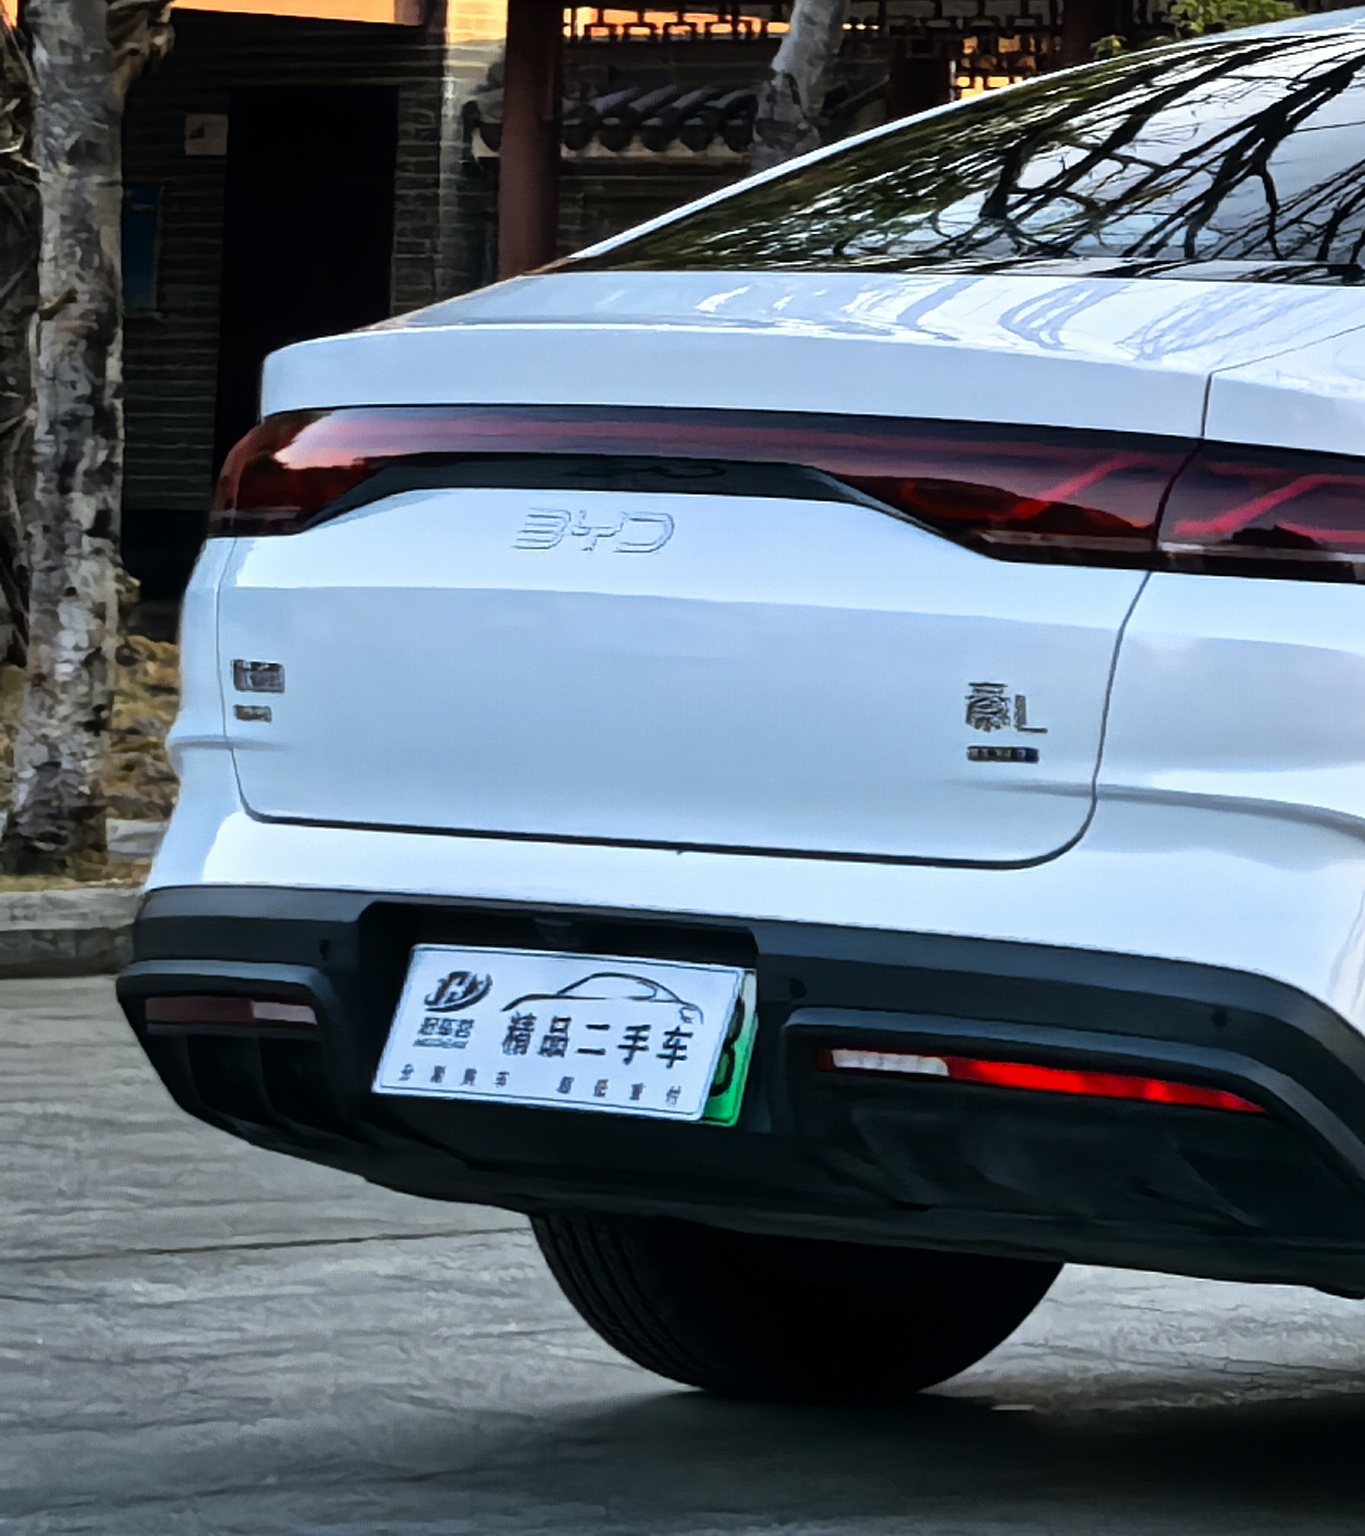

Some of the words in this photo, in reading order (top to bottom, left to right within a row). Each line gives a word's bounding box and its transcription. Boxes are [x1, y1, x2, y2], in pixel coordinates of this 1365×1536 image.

[511, 507, 675, 554] BYD
[501, 1012, 694, 1069] 精品二手车
